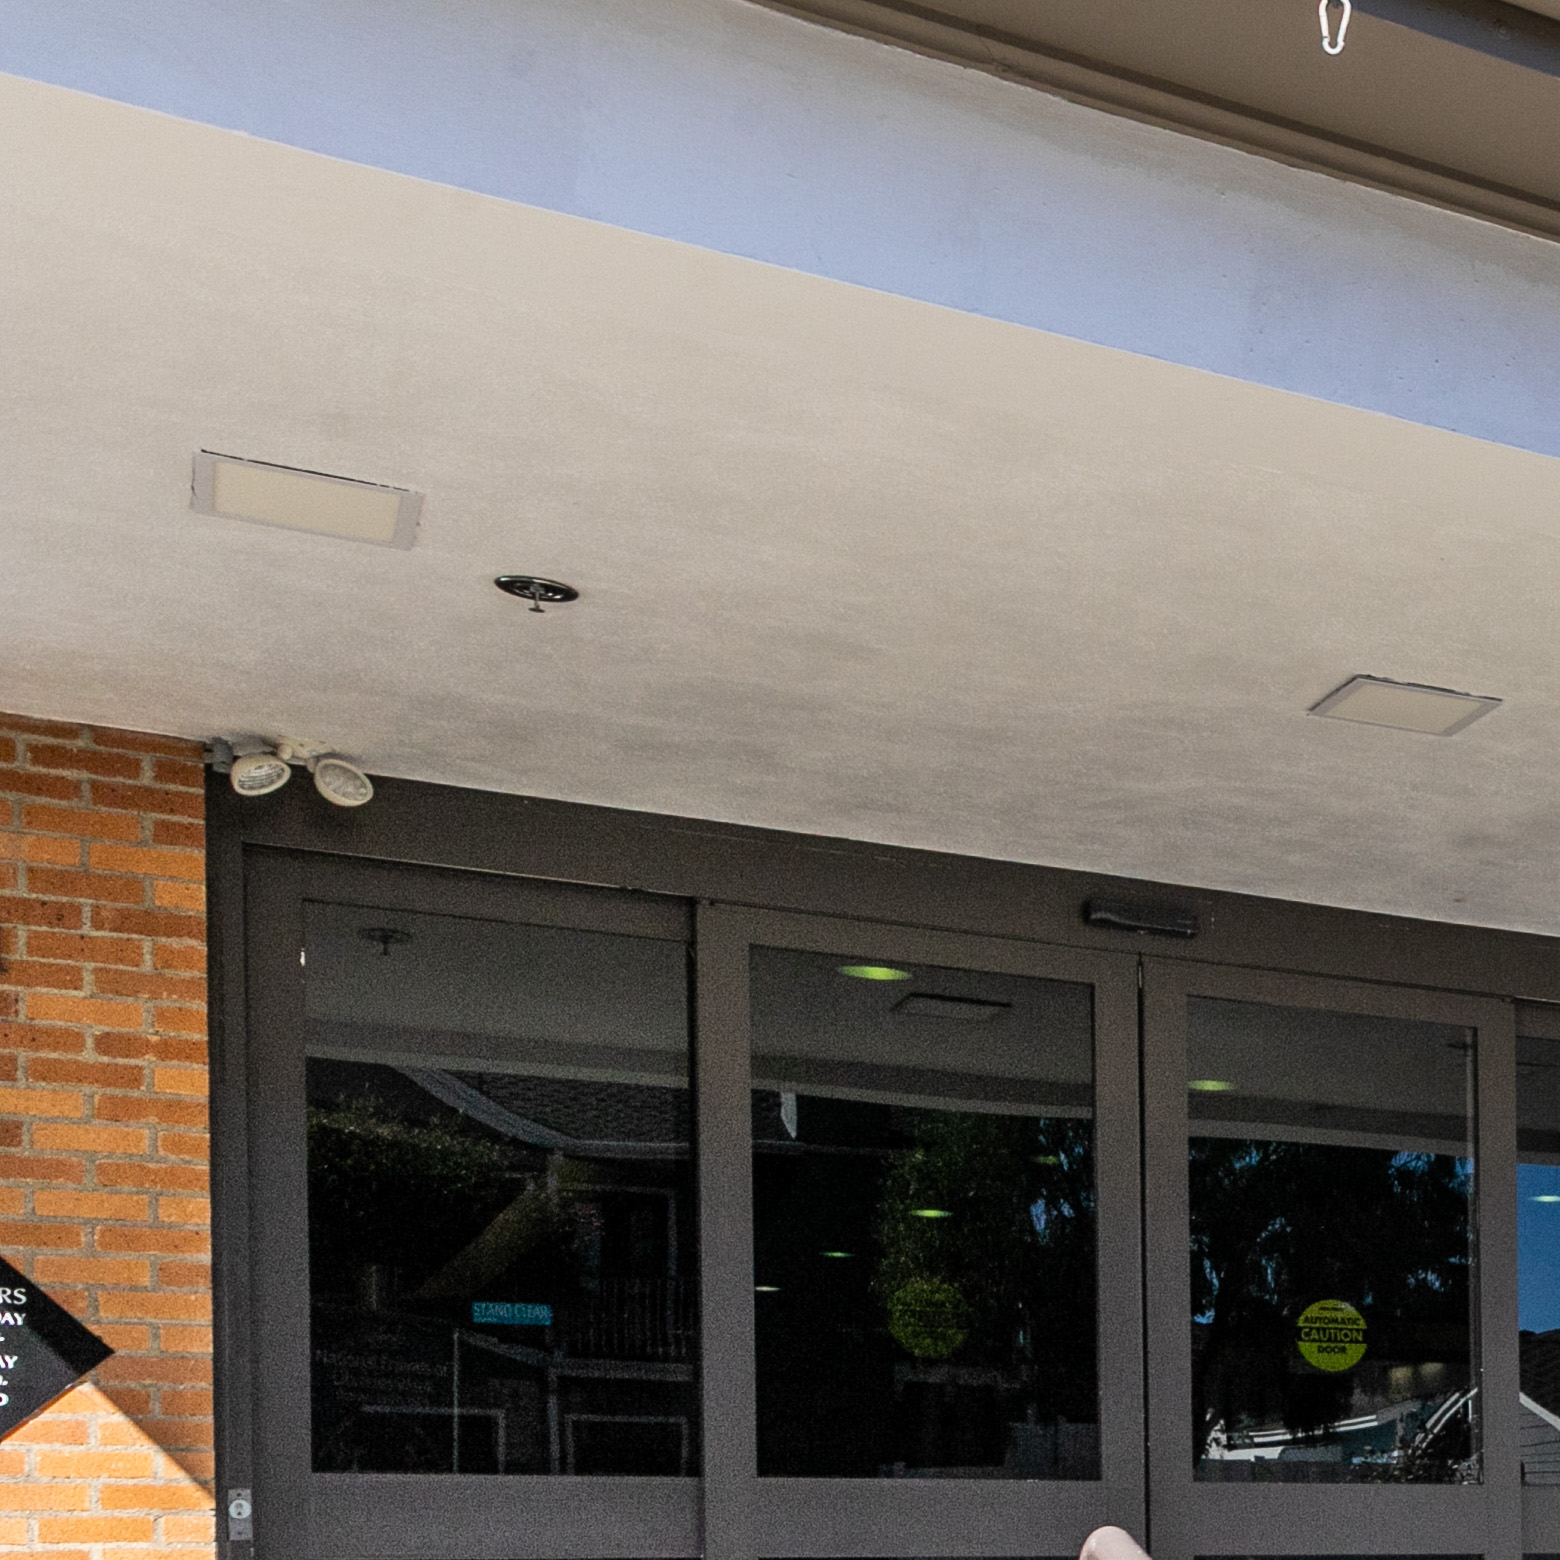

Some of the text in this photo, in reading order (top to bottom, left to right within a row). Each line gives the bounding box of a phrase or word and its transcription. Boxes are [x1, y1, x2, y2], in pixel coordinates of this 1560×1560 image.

[1303, 1316, 1361, 1326] AUTOMATIC
[1301, 1328, 1363, 1341] CAUTION
[1317, 1345, 1347, 1354] DOOR
